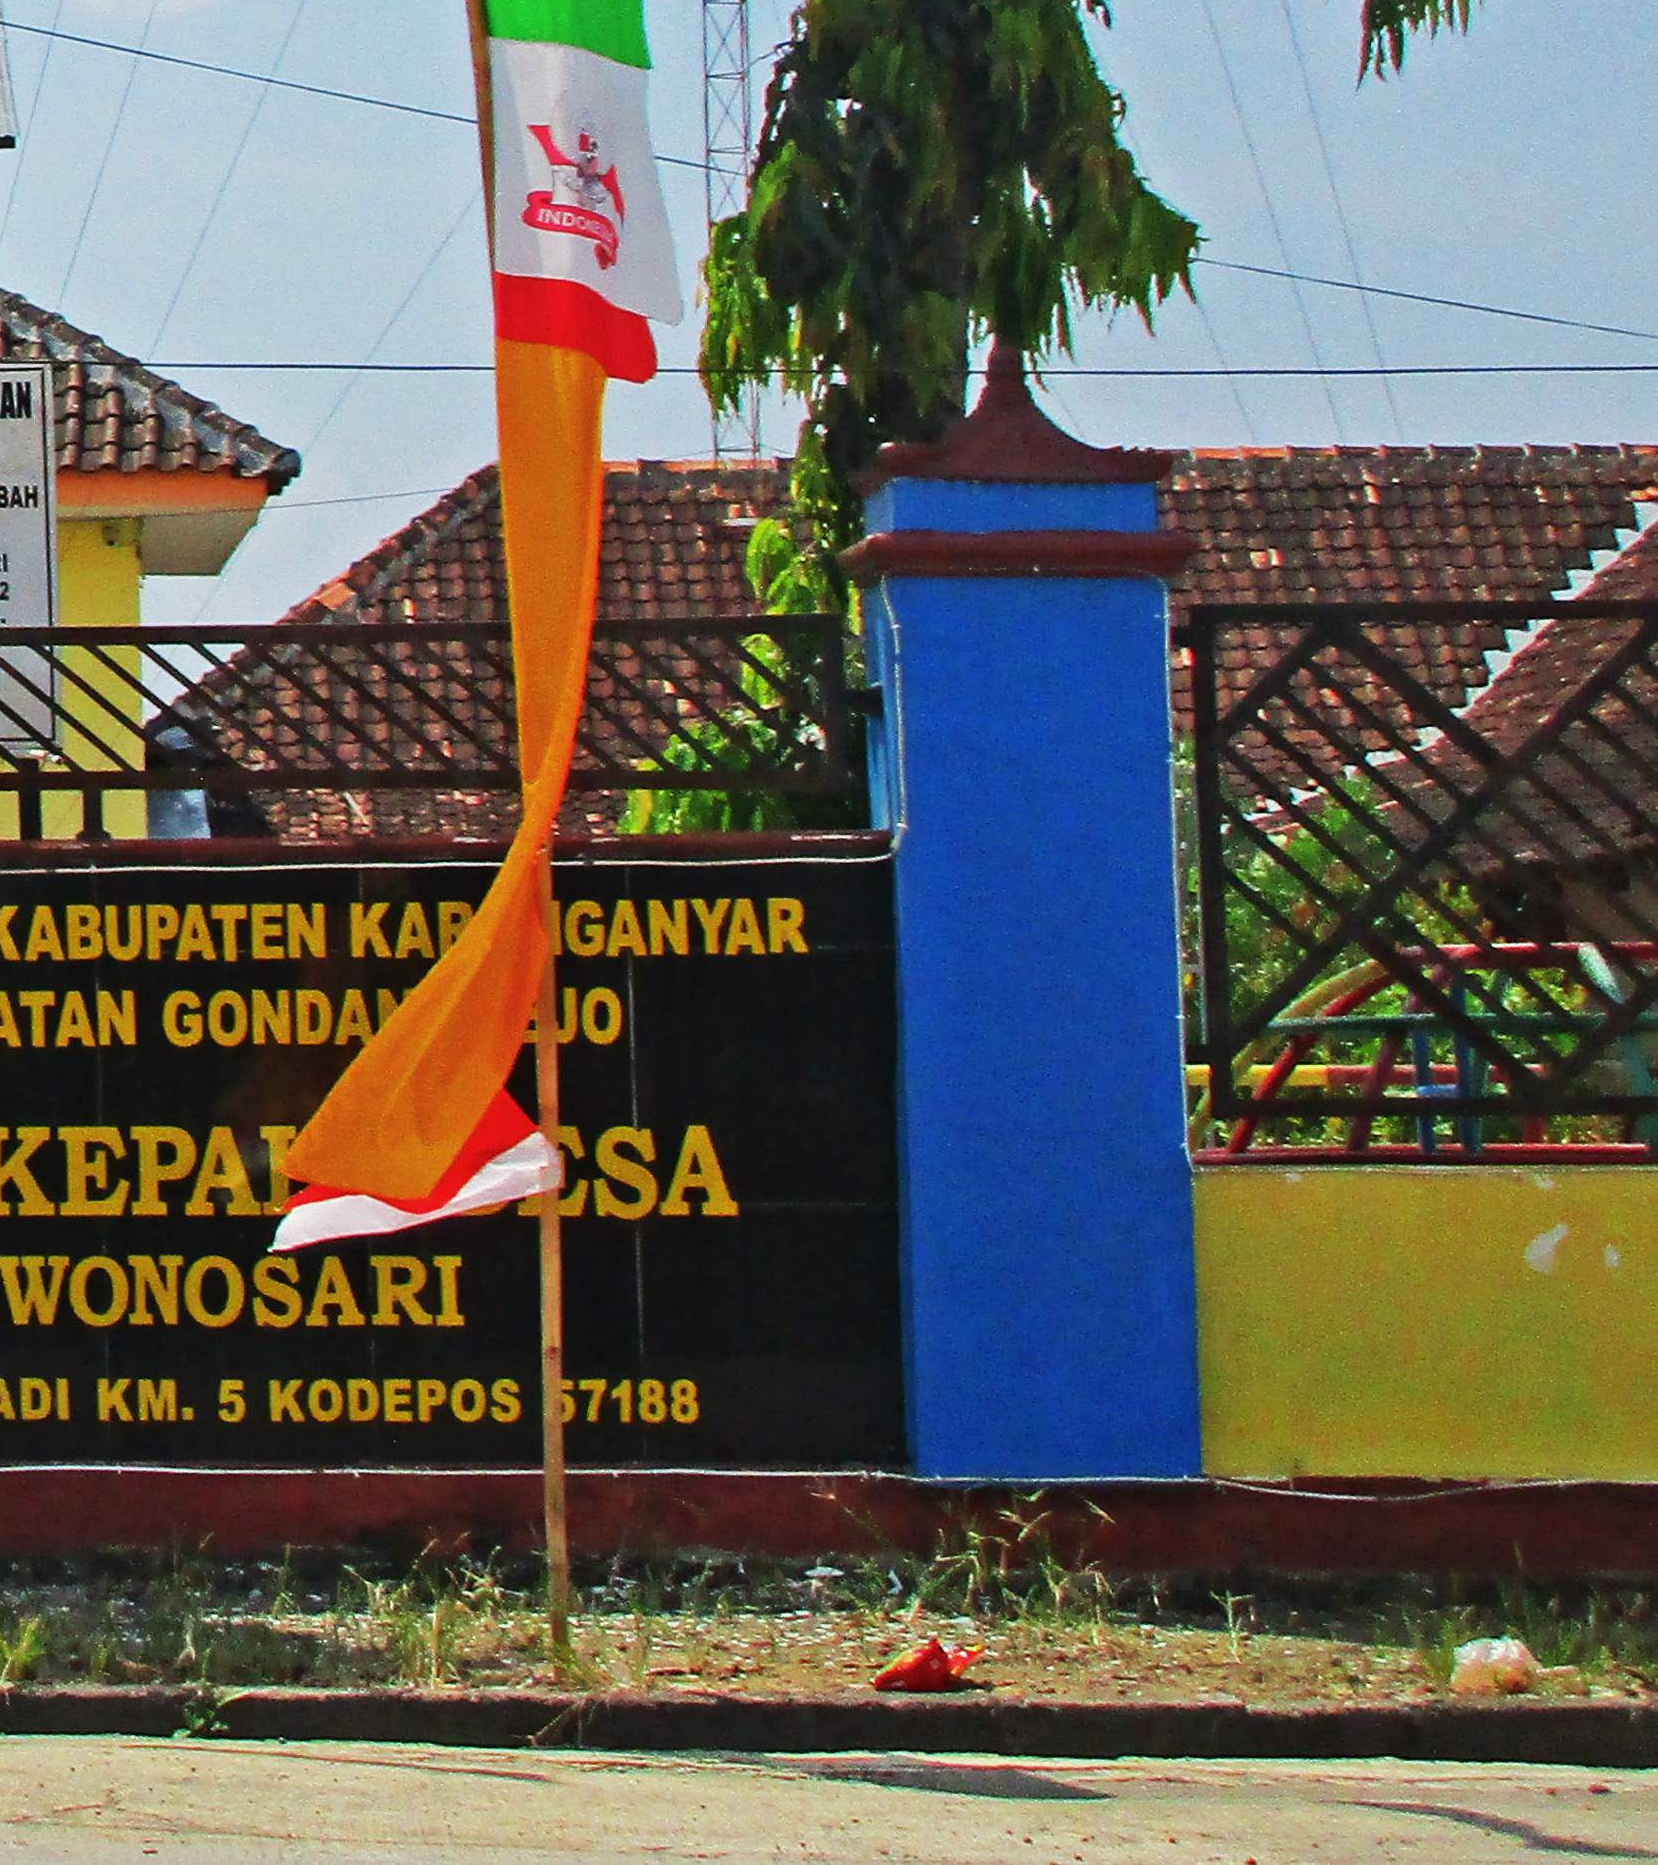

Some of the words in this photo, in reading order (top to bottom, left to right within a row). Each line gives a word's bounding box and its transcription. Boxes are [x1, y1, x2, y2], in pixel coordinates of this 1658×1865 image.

[349, 897, 809, 960] KARGANYAR
[162, 986, 623, 1047] GONDAJO
[455, 1124, 739, 1221] ESA
[97, 1378, 195, 1422] KM.
[217, 1379, 247, 1423] 5
[269, 1378, 521, 1424] KODEPOS
